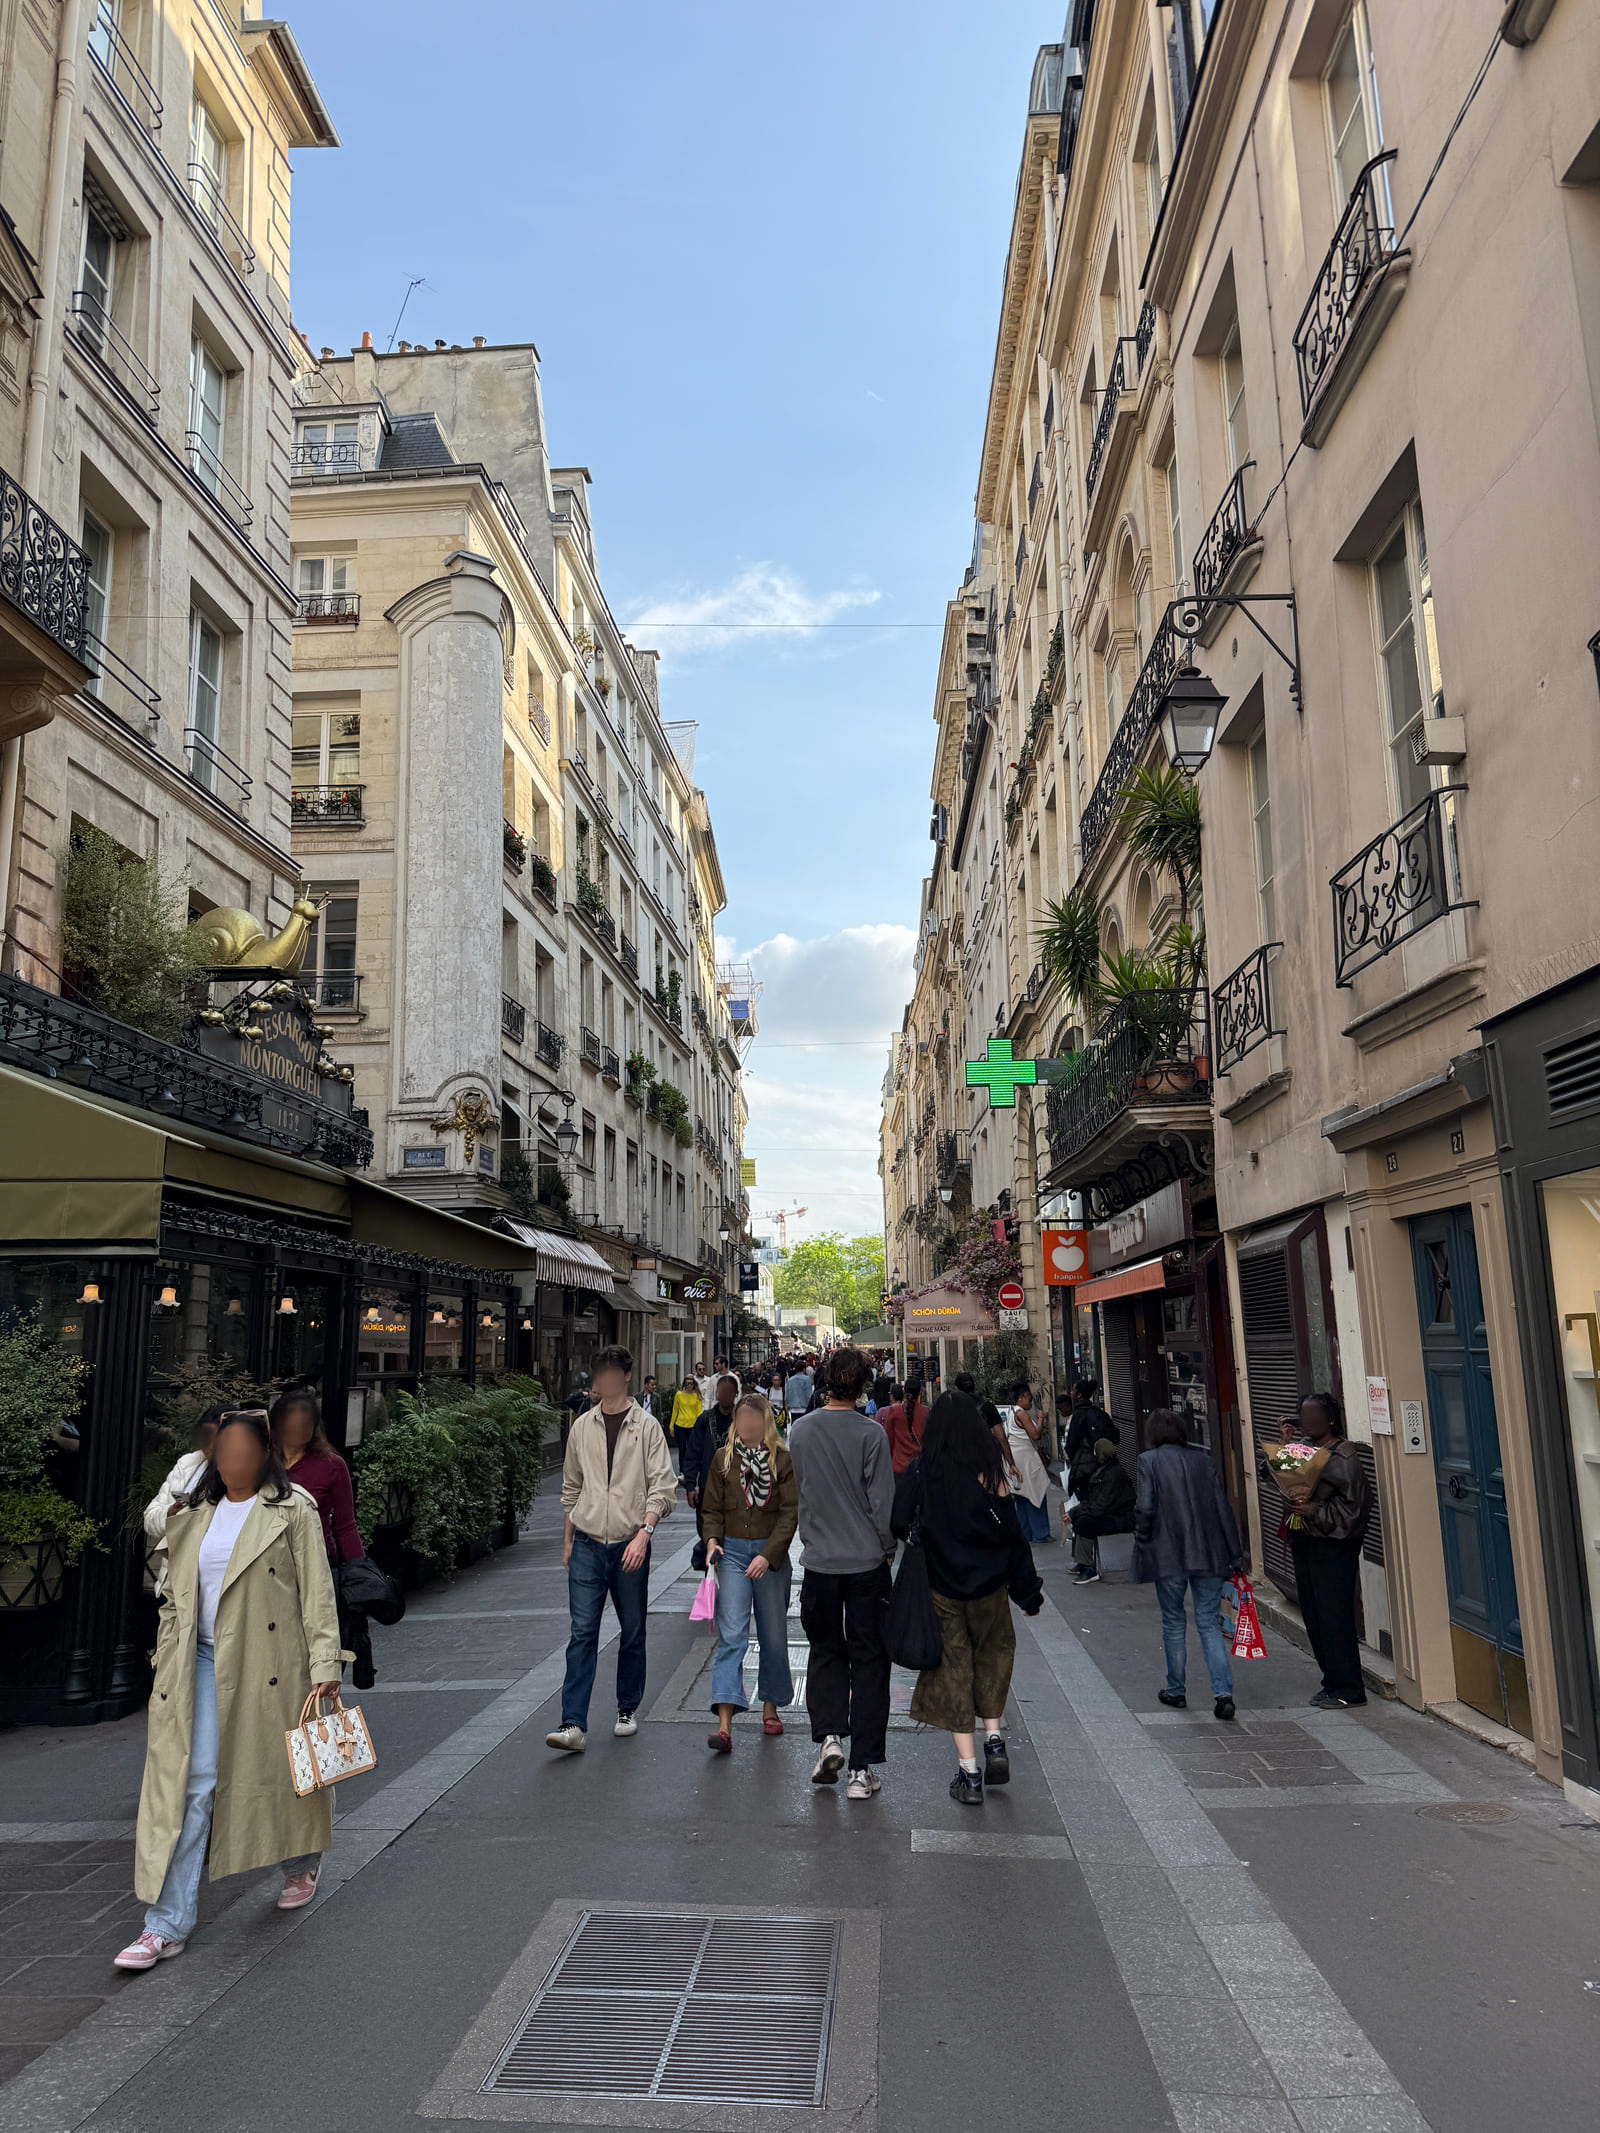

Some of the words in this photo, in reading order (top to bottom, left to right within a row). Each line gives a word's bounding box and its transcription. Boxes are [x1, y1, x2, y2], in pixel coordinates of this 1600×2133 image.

[240, 1040, 322, 1099] MONTORGUEIL
[1452, 1133, 1463, 1153] 27
[683, 1286, 707, 1299] Wic
[912, 1308, 936, 1316] SCHÖN
[937, 1307, 961, 1315] DÜRÜM
[915, 1326, 934, 1334] HOME
[934, 1325, 952, 1333] MADE
